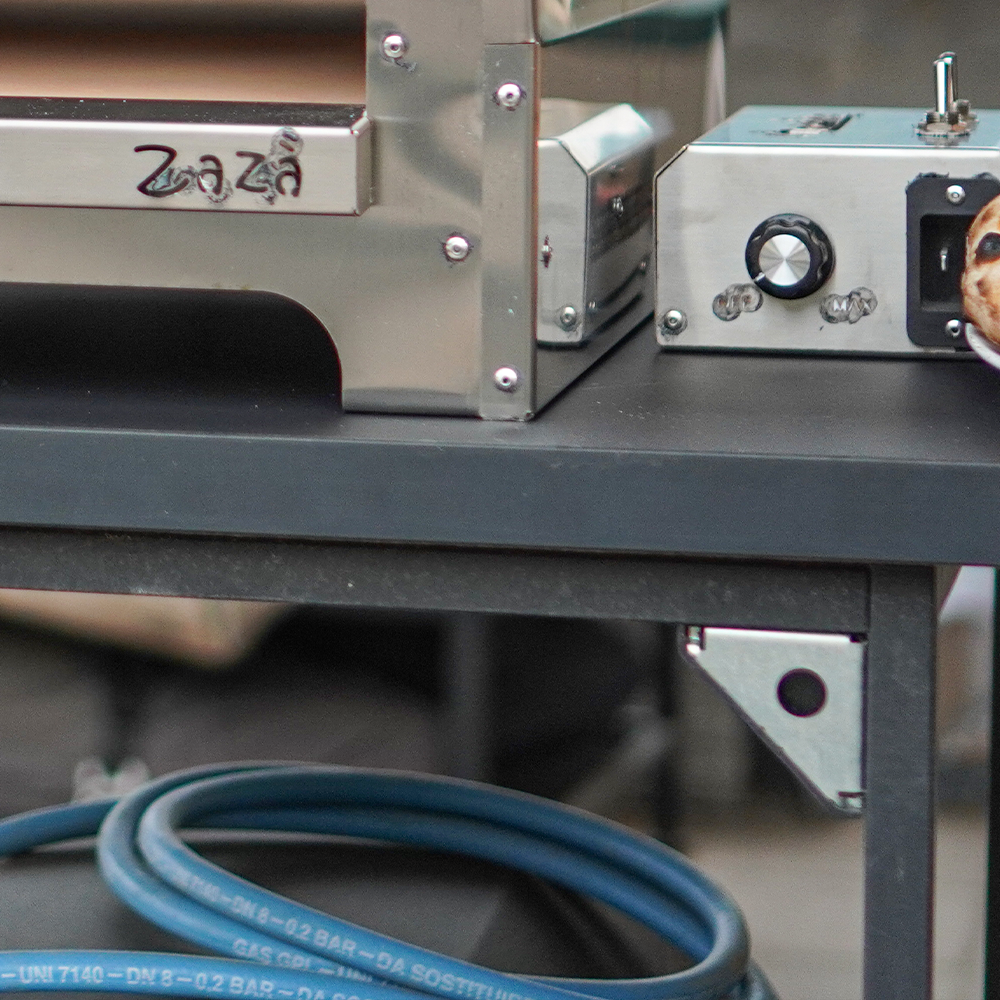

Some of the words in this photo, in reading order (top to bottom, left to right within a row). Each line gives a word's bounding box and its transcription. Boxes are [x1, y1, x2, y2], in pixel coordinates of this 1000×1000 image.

[313, 928, 357, 958] BAR
[375, 951, 406, 976] DA
[19, 965, 53, 984] UNI
[57, 965, 104, 984] 7140
[126, 966, 156, 985] DN
[162, 969, 173, 987] 8
[229, 976, 275, 999] BAR
